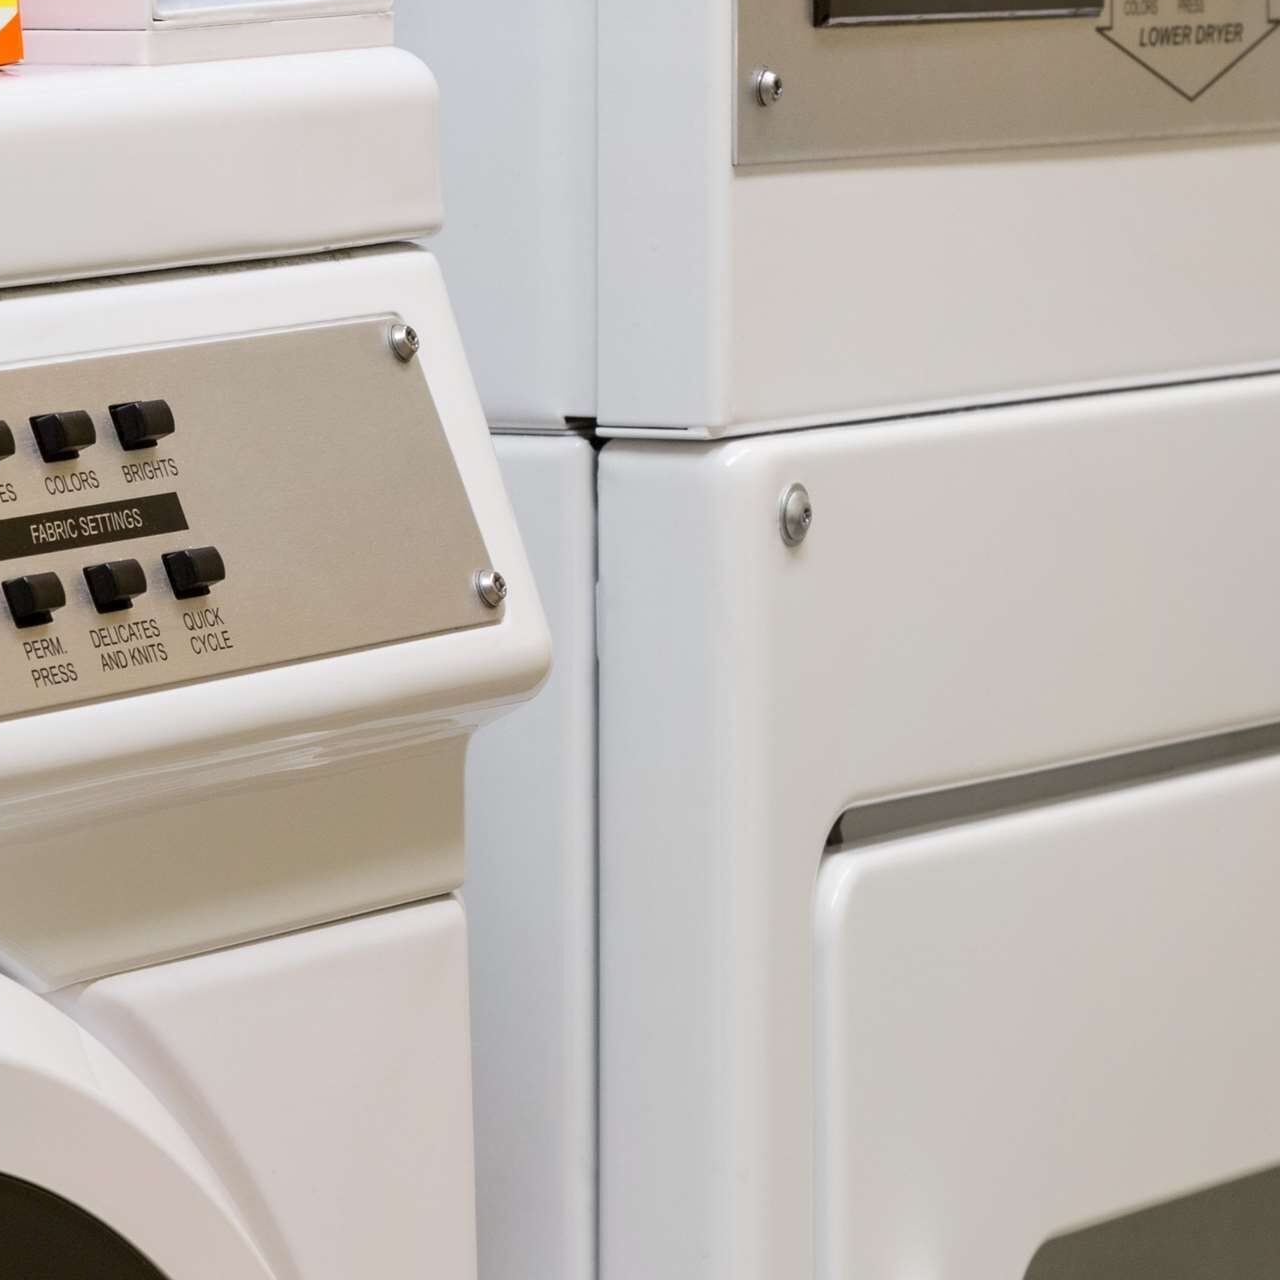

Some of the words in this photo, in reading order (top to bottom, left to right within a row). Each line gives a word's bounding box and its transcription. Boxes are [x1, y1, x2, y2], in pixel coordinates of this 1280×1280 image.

[1124, 0, 1158, 16] COLORS
[1139, 24, 1192, 47] LOWER
[1195, 23, 1244, 45] DRYER
[44, 470, 100, 495] COLORS
[121, 458, 179, 484] BRIGHTS
[30, 519, 77, 544] FABRIC
[79, 508, 143, 538] SETTINGS
[183, 607, 225, 632] QUICK
[89, 619, 161, 649] DELICATES
[190, 630, 234, 655] CYCLE
[23, 637, 68, 661] PERM.
[100, 650, 129, 673] AND
[131, 642, 169, 668] KNITS
[31, 663, 79, 688] PRESS
